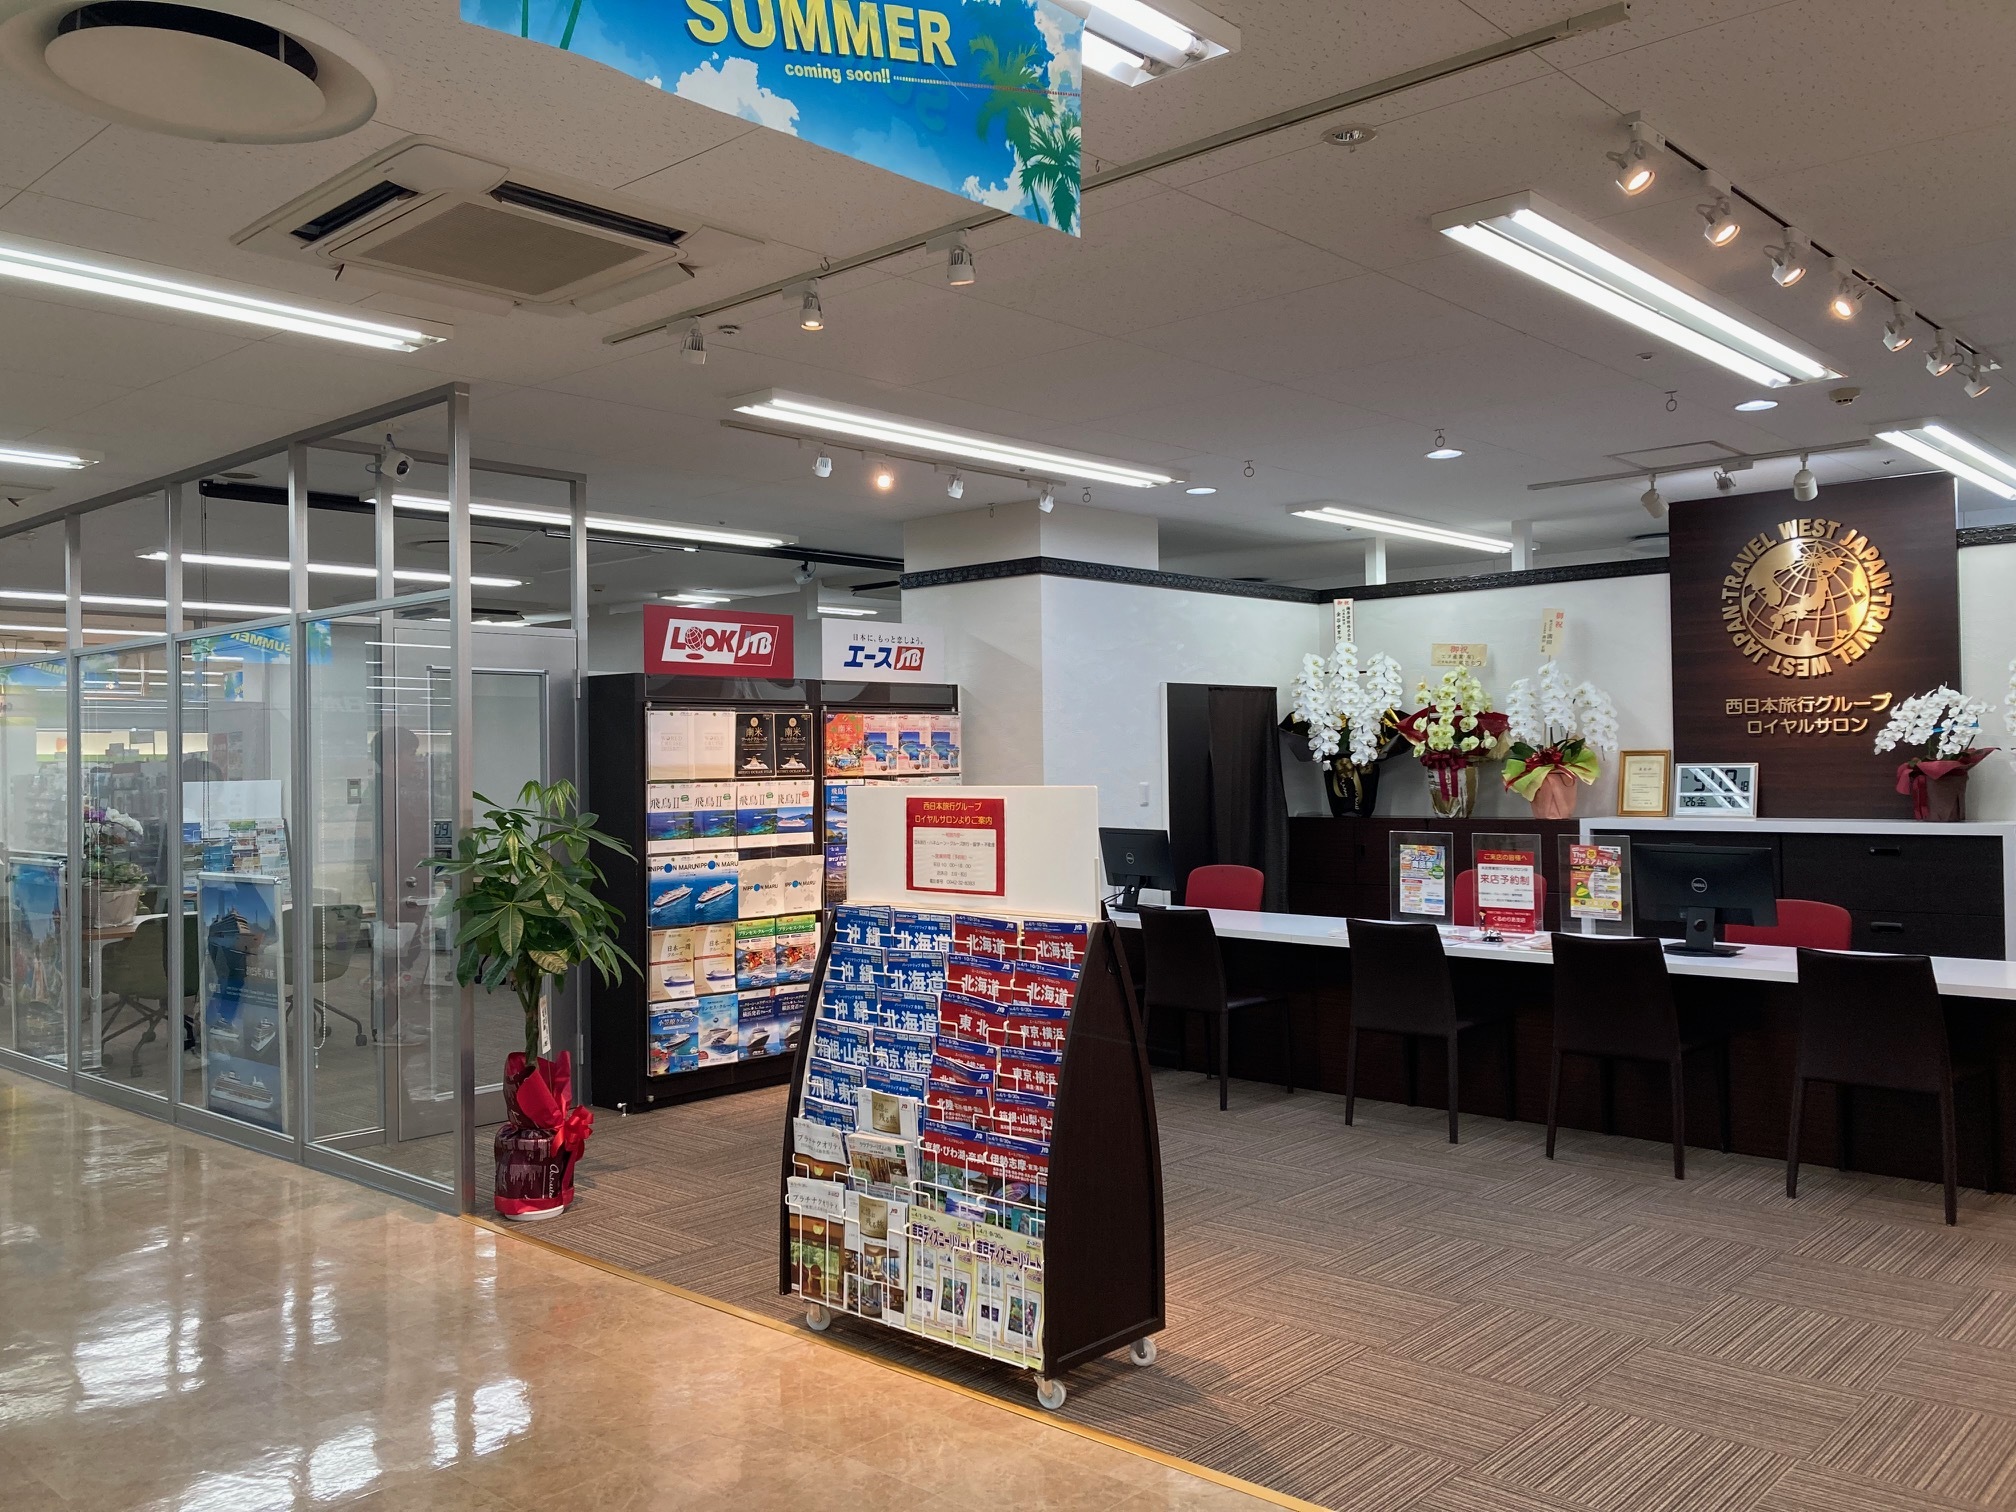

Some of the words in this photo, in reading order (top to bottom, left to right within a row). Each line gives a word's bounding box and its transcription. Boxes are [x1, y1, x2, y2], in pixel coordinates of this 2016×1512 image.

[687, 0, 957, 67] SUMMER
[784, 63, 842, 84] coming
[845, 68, 892, 84] soon!!
[1722, 532, 1777, 600] TRAVEL
[1778, 518, 1841, 540] WEST
[1839, 529, 1892, 590] JAPAN
[670, 625, 738, 653] LOOK
[738, 630, 773, 658] JTB
[853, 633, 924, 645] 日本に、もっと恋しよう。
[843, 645, 892, 668] エース
[895, 647, 922, 670] JTB
[1767, 655, 1833, 678] WEST
[1725, 692, 1892, 715] 西日本旅行グループ
[1747, 717, 1868, 736] ロイヤルサロン
[923, 801, 982, 811] 西日本旅行グループ
[915, 814, 993, 826] ロイヤルサロンよりご案内
[1483, 853, 1528, 861] ご来店の皆様へ
[1480, 874, 1530, 886] 来店予約制
[847, 924, 881, 947] 沖縄
[896, 930, 951, 953] 北海道
[966, 934, 1006, 955] 北海道
[1036, 940, 1076, 960] 北海道
[841, 961, 875, 984] 沖縄
[890, 969, 945, 993] 北海道
[961, 974, 1000, 998] 北海道
[1026, 982, 1069, 1007] 北海道
[834, 999, 870, 1022] 沖縄
[882, 1009, 938, 1033] 北海道
[958, 1014, 989, 1038] 東北
[1020, 1024, 1065, 1041] 東京・横浜
[817, 1037, 870, 1066] 箱根・山梨
[1012, 1067, 1057, 1086] 東京・横浜
[924, 1141, 985, 1166] 京都・びわ湖・奈良
